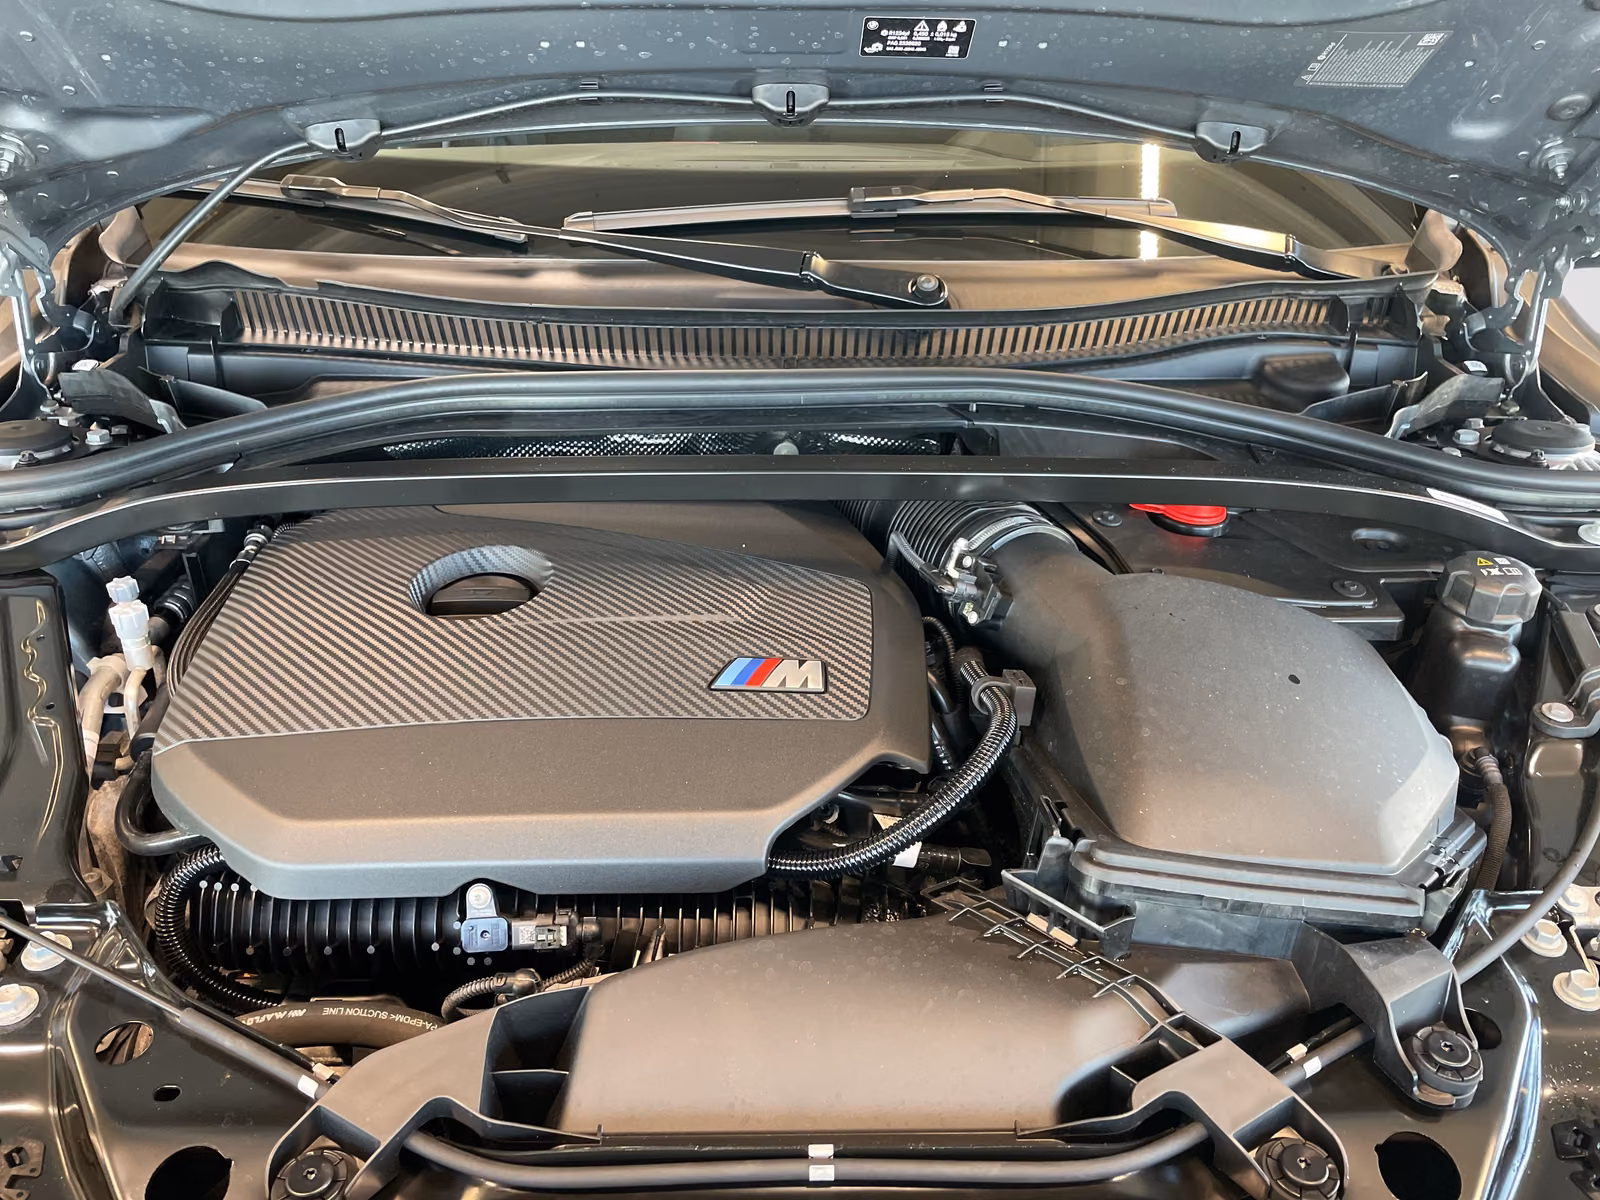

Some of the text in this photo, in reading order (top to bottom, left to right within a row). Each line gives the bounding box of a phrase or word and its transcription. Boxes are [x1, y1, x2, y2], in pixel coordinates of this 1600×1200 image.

[761, 659, 823, 689] M
[241, 1010, 287, 1026] MAFLO
[322, 1007, 345, 1017] LINE
[346, 1008, 388, 1020] SUCTION
